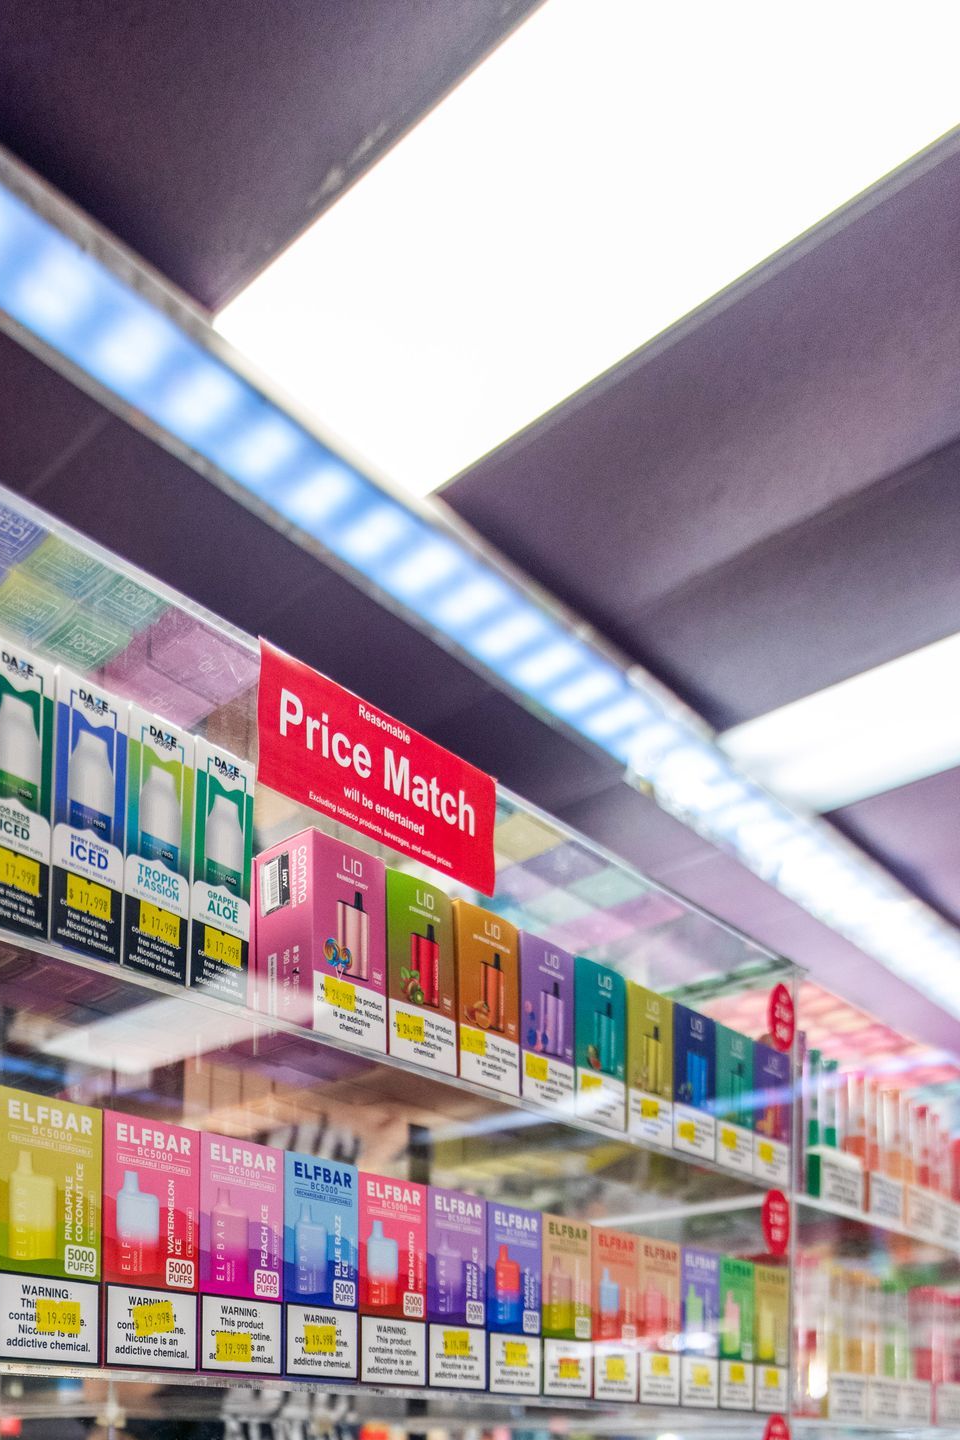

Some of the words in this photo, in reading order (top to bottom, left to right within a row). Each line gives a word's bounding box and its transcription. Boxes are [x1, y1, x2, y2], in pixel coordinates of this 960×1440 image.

[1, 652, 34, 675] DAZE
[79, 689, 108, 713] DAZE
[358, 703, 411, 745] Reasonable
[149, 725, 177, 749] DAZE
[214, 756, 240, 777] DAZE
[279, 687, 372, 779] Price
[384, 746, 475, 838] Match
[343, 787, 360, 804] will
[362, 793, 373, 810] be
[375, 803, 425, 837] entertained
[0, 819, 30, 841] ICED
[70, 833, 88, 847] BERRY
[309, 790, 337, 814] Excluding
[337, 804, 359, 822] tobacco
[358, 815, 384, 837] products,
[384, 828, 411, 849] beverages,
[411, 841, 421, 853] and
[422, 846, 436, 861] online
[437, 854, 453, 869] prices.
[70, 841, 109, 871] ICED
[138, 863, 179, 891] TROPIC
[297, 845, 307, 905] comma
[137, 876, 180, 902] PASSION
[207, 890, 239, 910] GRAPPLE
[207, 901, 239, 925] ALOE
[7, 1098, 93, 1136] ELFBAR
[116, 1122, 191, 1156] ELFBAR
[137, 1148, 173, 1162] BC5000
[210, 1142, 276, 1173] ELFBAR
[76, 1162, 84, 1187] ICE
[294, 1160, 352, 1189] ELFBAR
[310, 1182, 338, 1195] BC5000
[366, 1180, 420, 1206] ELFBAR
[64, 1175, 74, 1241] PINEAPPLE
[75, 1188, 84, 1242] COCONUT
[167, 1179, 175, 1254] WATERMELON
[435, 1195, 482, 1219] ELFBAR
[494, 1210, 537, 1232] ELFBAR
[549, 1221, 588, 1242] ELFBAR
[67, 1248, 95, 1264] 5000
[260, 1226, 268, 1268] PEACH
[407, 1231, 415, 1268] MOJITO
[67, 1262, 95, 1273] PUFFS
[168, 1262, 192, 1275] 5000
[334, 1247, 342, 1277] BLUE
[168, 1274, 192, 1284] PUFFS
[256, 1272, 278, 1286] 5000
[256, 1284, 278, 1295] PUFFS
[407, 1269, 415, 1290] RED
[220, 1316, 236, 1327] This
[237, 1319, 264, 1331] product
